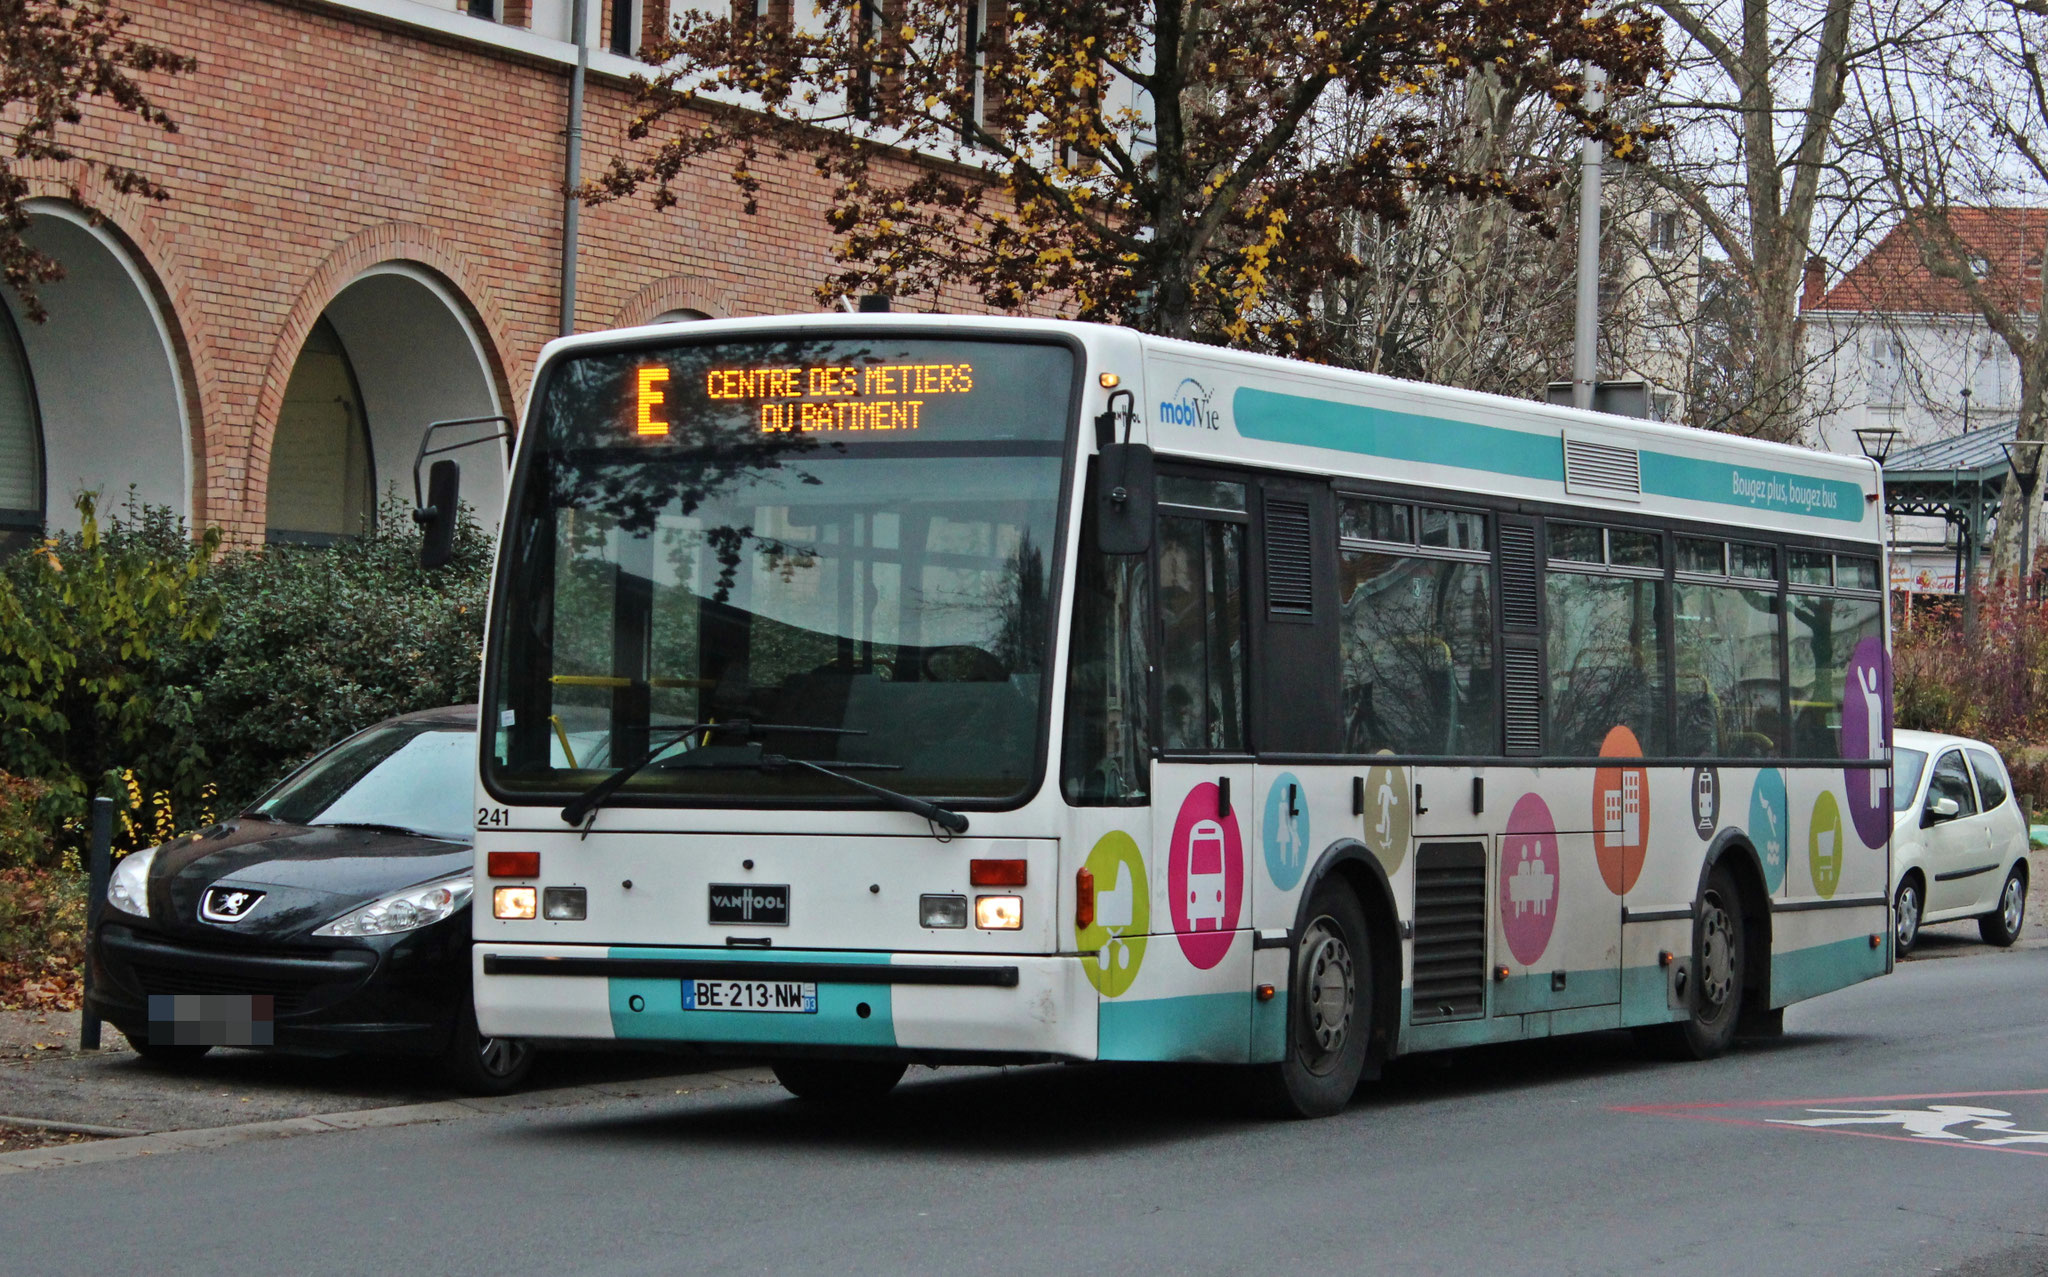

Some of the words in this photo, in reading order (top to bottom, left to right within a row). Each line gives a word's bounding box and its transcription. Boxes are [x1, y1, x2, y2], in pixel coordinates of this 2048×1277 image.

[707, 368, 802, 399] CENTRE
[809, 366, 858, 397] DES
[865, 363, 974, 395] METIERS
[636, 367, 670, 436] E
[760, 403, 795, 433] DU
[801, 401, 924, 432] BATIMENT
[1160, 397, 1220, 431] mobiVie
[1732, 471, 1766, 504] Bougez
[1767, 475, 1788, 506] plus,
[1789, 479, 1821, 512] bougez
[1822, 483, 1838, 509] bus
[477, 807, 509, 827] 241
